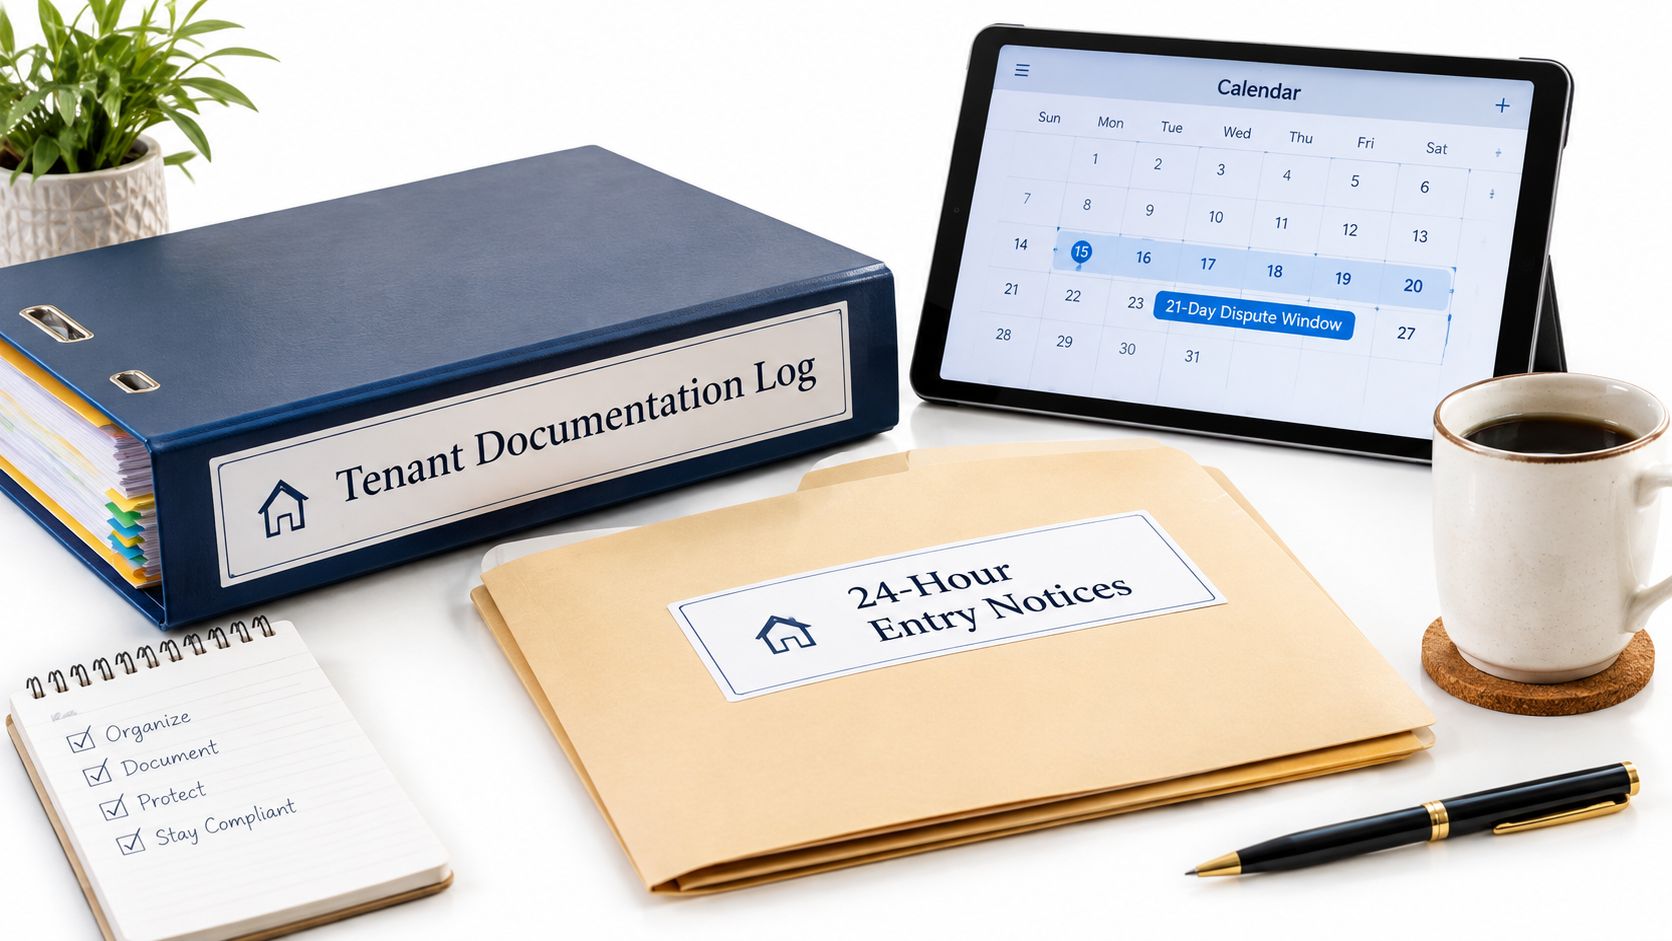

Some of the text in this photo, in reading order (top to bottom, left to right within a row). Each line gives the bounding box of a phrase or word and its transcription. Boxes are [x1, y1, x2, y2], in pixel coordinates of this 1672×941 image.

[1217, 78, 1302, 101] Calendar
[1038, 110, 1448, 155] Sun Mon Tue Wed Thu Fri Sat
[1092, 152, 1430, 194] 1 2 3 4 5 6
[1023, 192, 1428, 244] 7 8 9 10 11 12 13
[1014, 237, 1423, 294] 14 15 16 17 18 19 20
[1003, 282, 1145, 310] 21 22 23
[1165, 299, 1342, 331] 21-Day Dispute Window
[995, 327, 1200, 364] 28 29 30 31
[1396, 325, 1416, 341] 27
[336, 358, 816, 502] Tenant Documentation Log
[848, 564, 1012, 609] 24-Hour
[867, 578, 1132, 642] Entry Notices
[106, 713, 191, 743] Organize
[121, 740, 219, 776] Document
[137, 781, 206, 811] Protect
[156, 799, 296, 845] Stay Compliant
